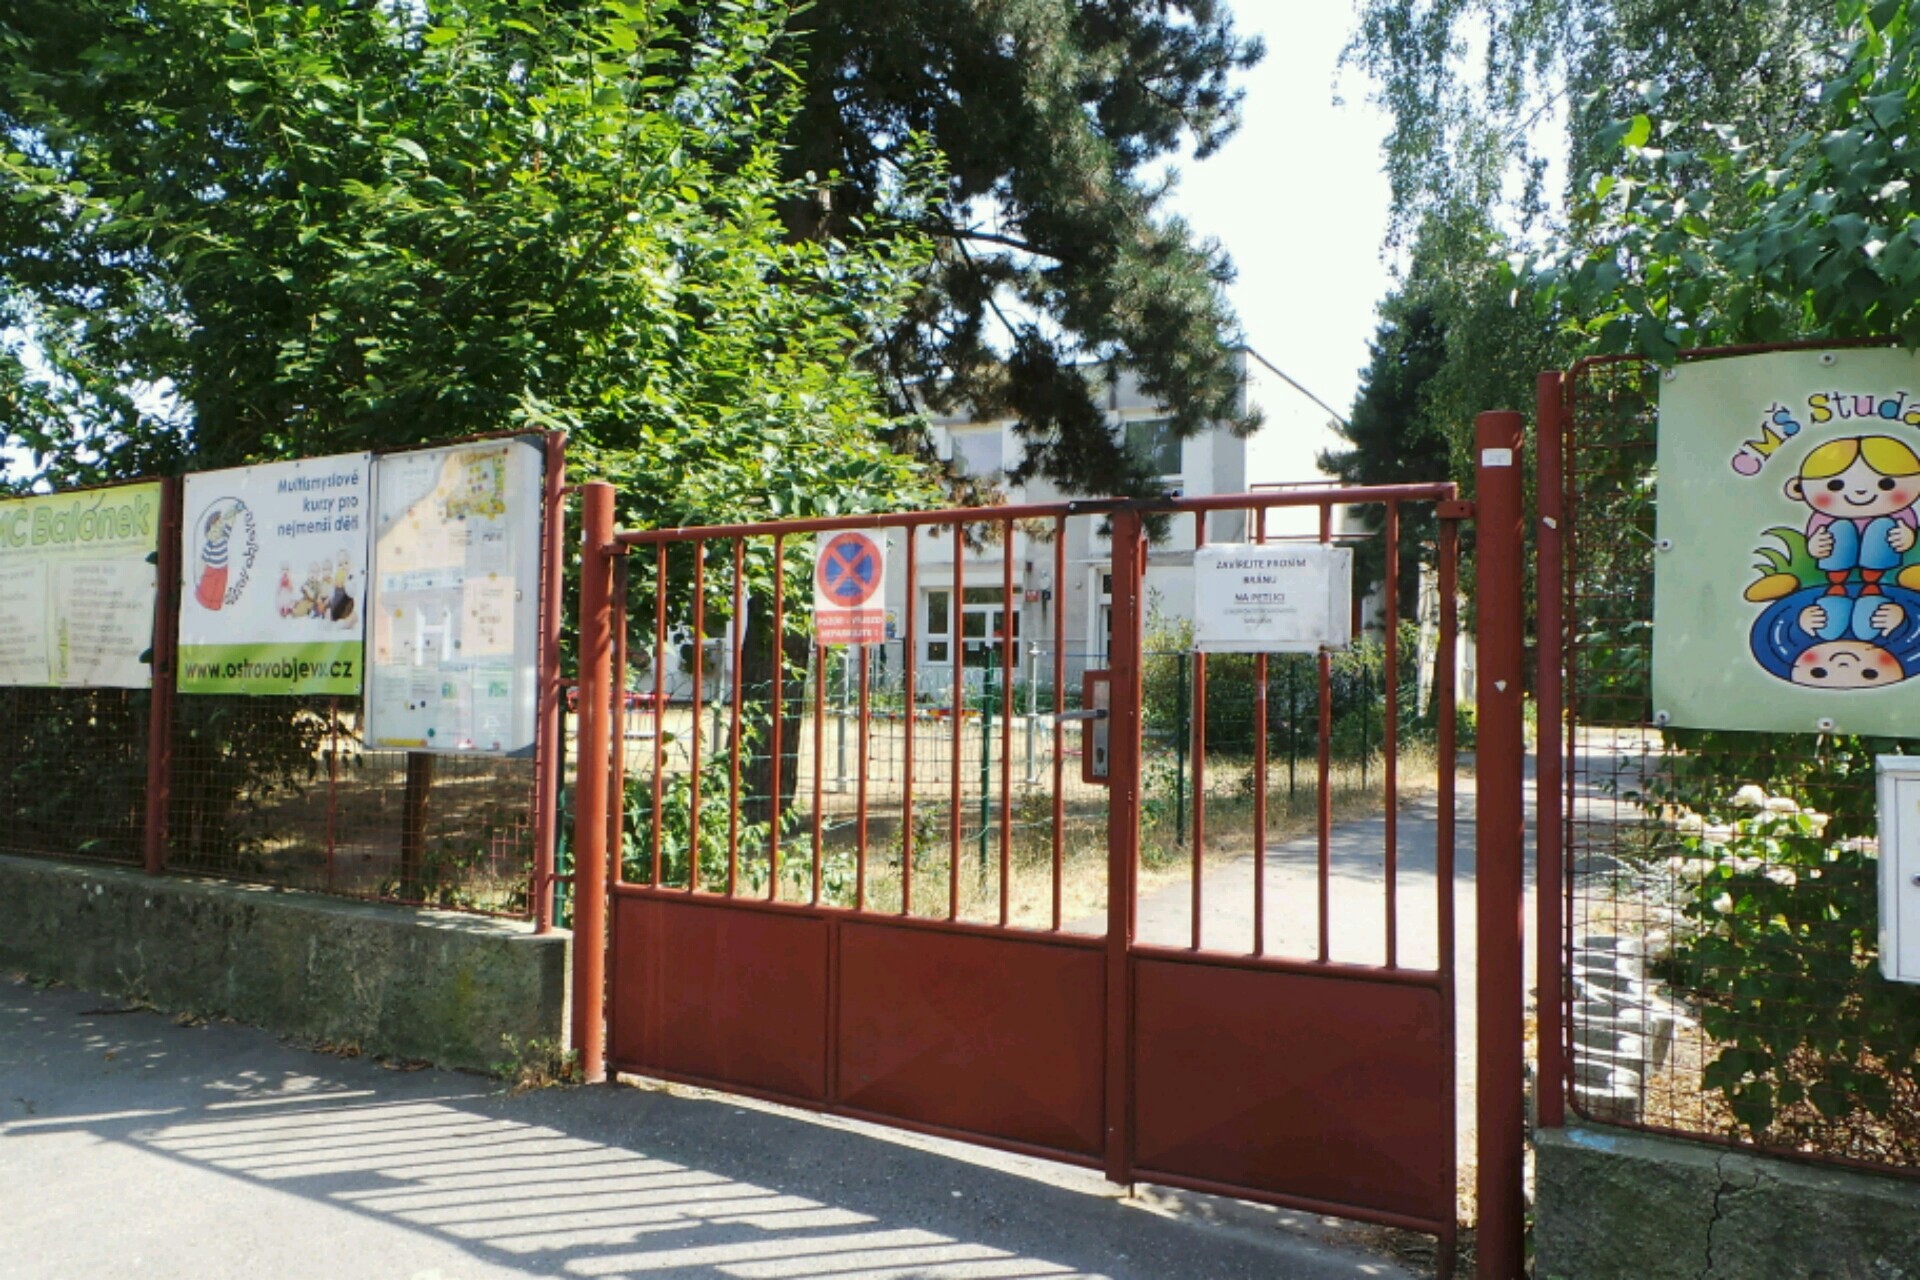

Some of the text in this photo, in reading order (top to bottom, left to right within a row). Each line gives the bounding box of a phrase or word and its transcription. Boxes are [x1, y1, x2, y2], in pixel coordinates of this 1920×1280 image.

[31, 492, 150, 546] Balónek
[303, 496, 359, 513] kurzy pro
